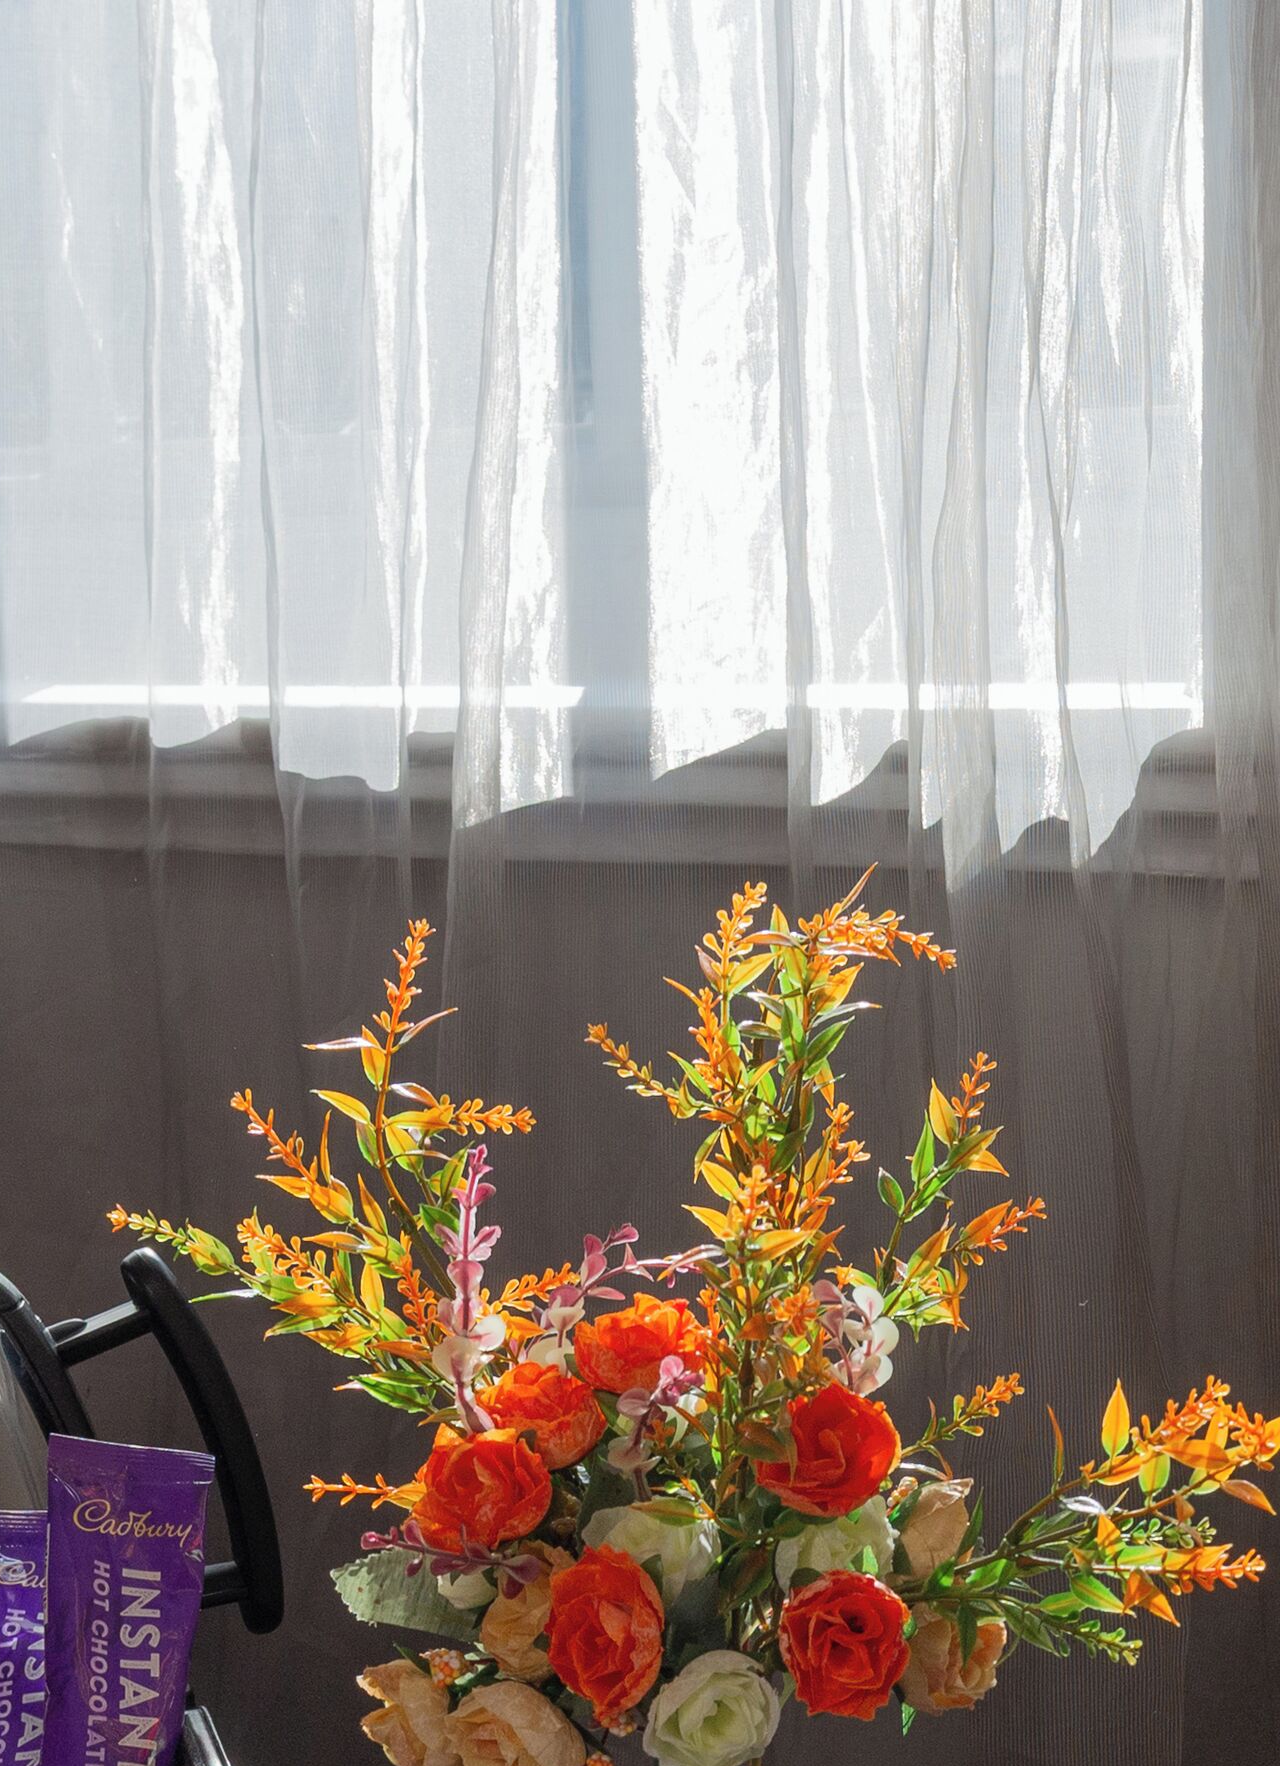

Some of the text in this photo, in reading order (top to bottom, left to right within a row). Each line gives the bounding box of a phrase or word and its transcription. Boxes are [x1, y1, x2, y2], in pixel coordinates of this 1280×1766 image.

[73, 1499, 193, 1548] Cadbury
[93, 1559, 110, 1613] HOT
[0, 1608, 26, 1651] HOT
